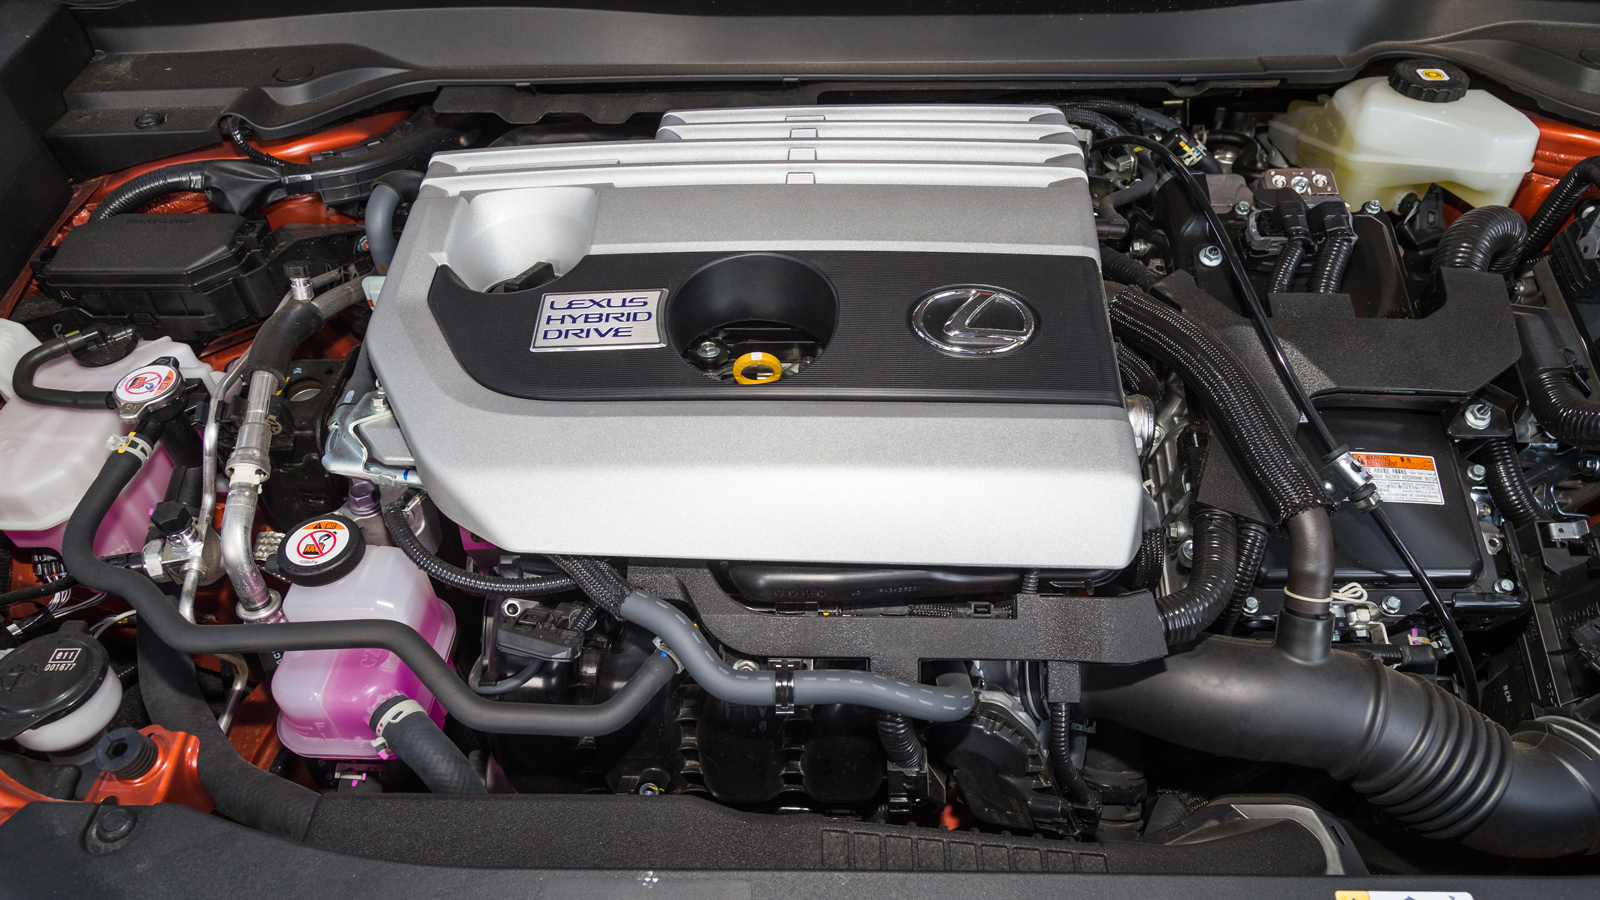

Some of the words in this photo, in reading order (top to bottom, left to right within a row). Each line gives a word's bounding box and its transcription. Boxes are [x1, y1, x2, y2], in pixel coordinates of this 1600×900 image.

[550, 296, 648, 310] LEXUS
[545, 311, 653, 325] HYBRID
[542, 326, 634, 340] DRIVE
[44, 663, 77, 672] 001677
